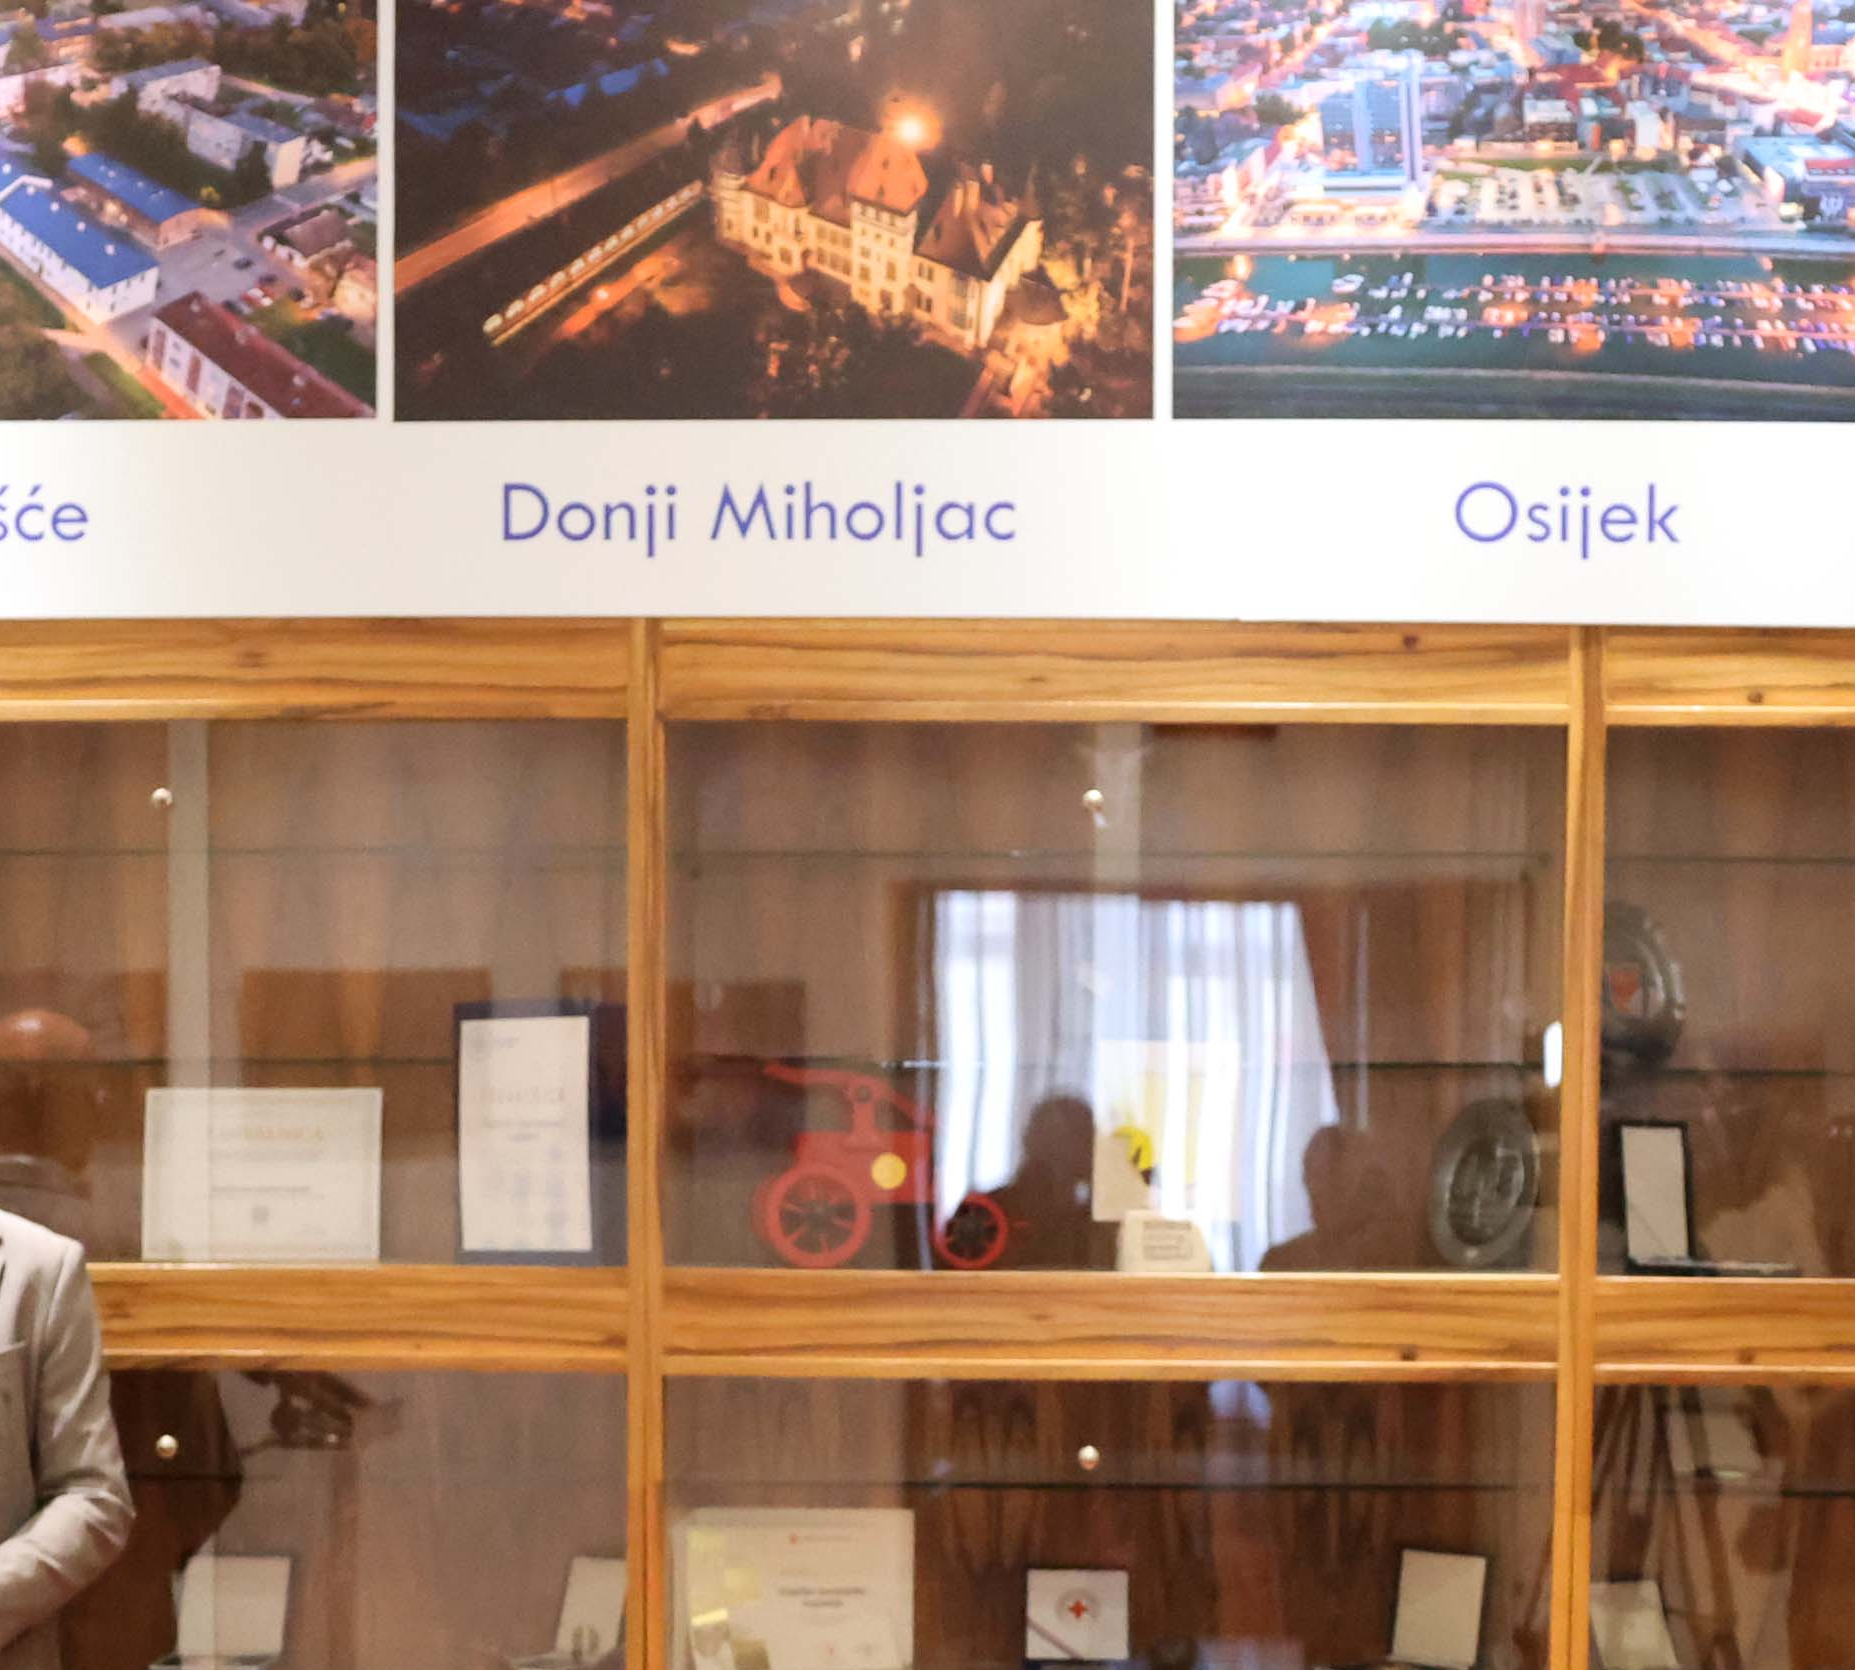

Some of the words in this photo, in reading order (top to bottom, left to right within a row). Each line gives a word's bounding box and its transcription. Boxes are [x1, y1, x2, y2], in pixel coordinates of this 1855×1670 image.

[502, 482, 678, 559] Donji
[711, 481, 1018, 558] Miholjac
[1454, 481, 1680, 562] Osijek
